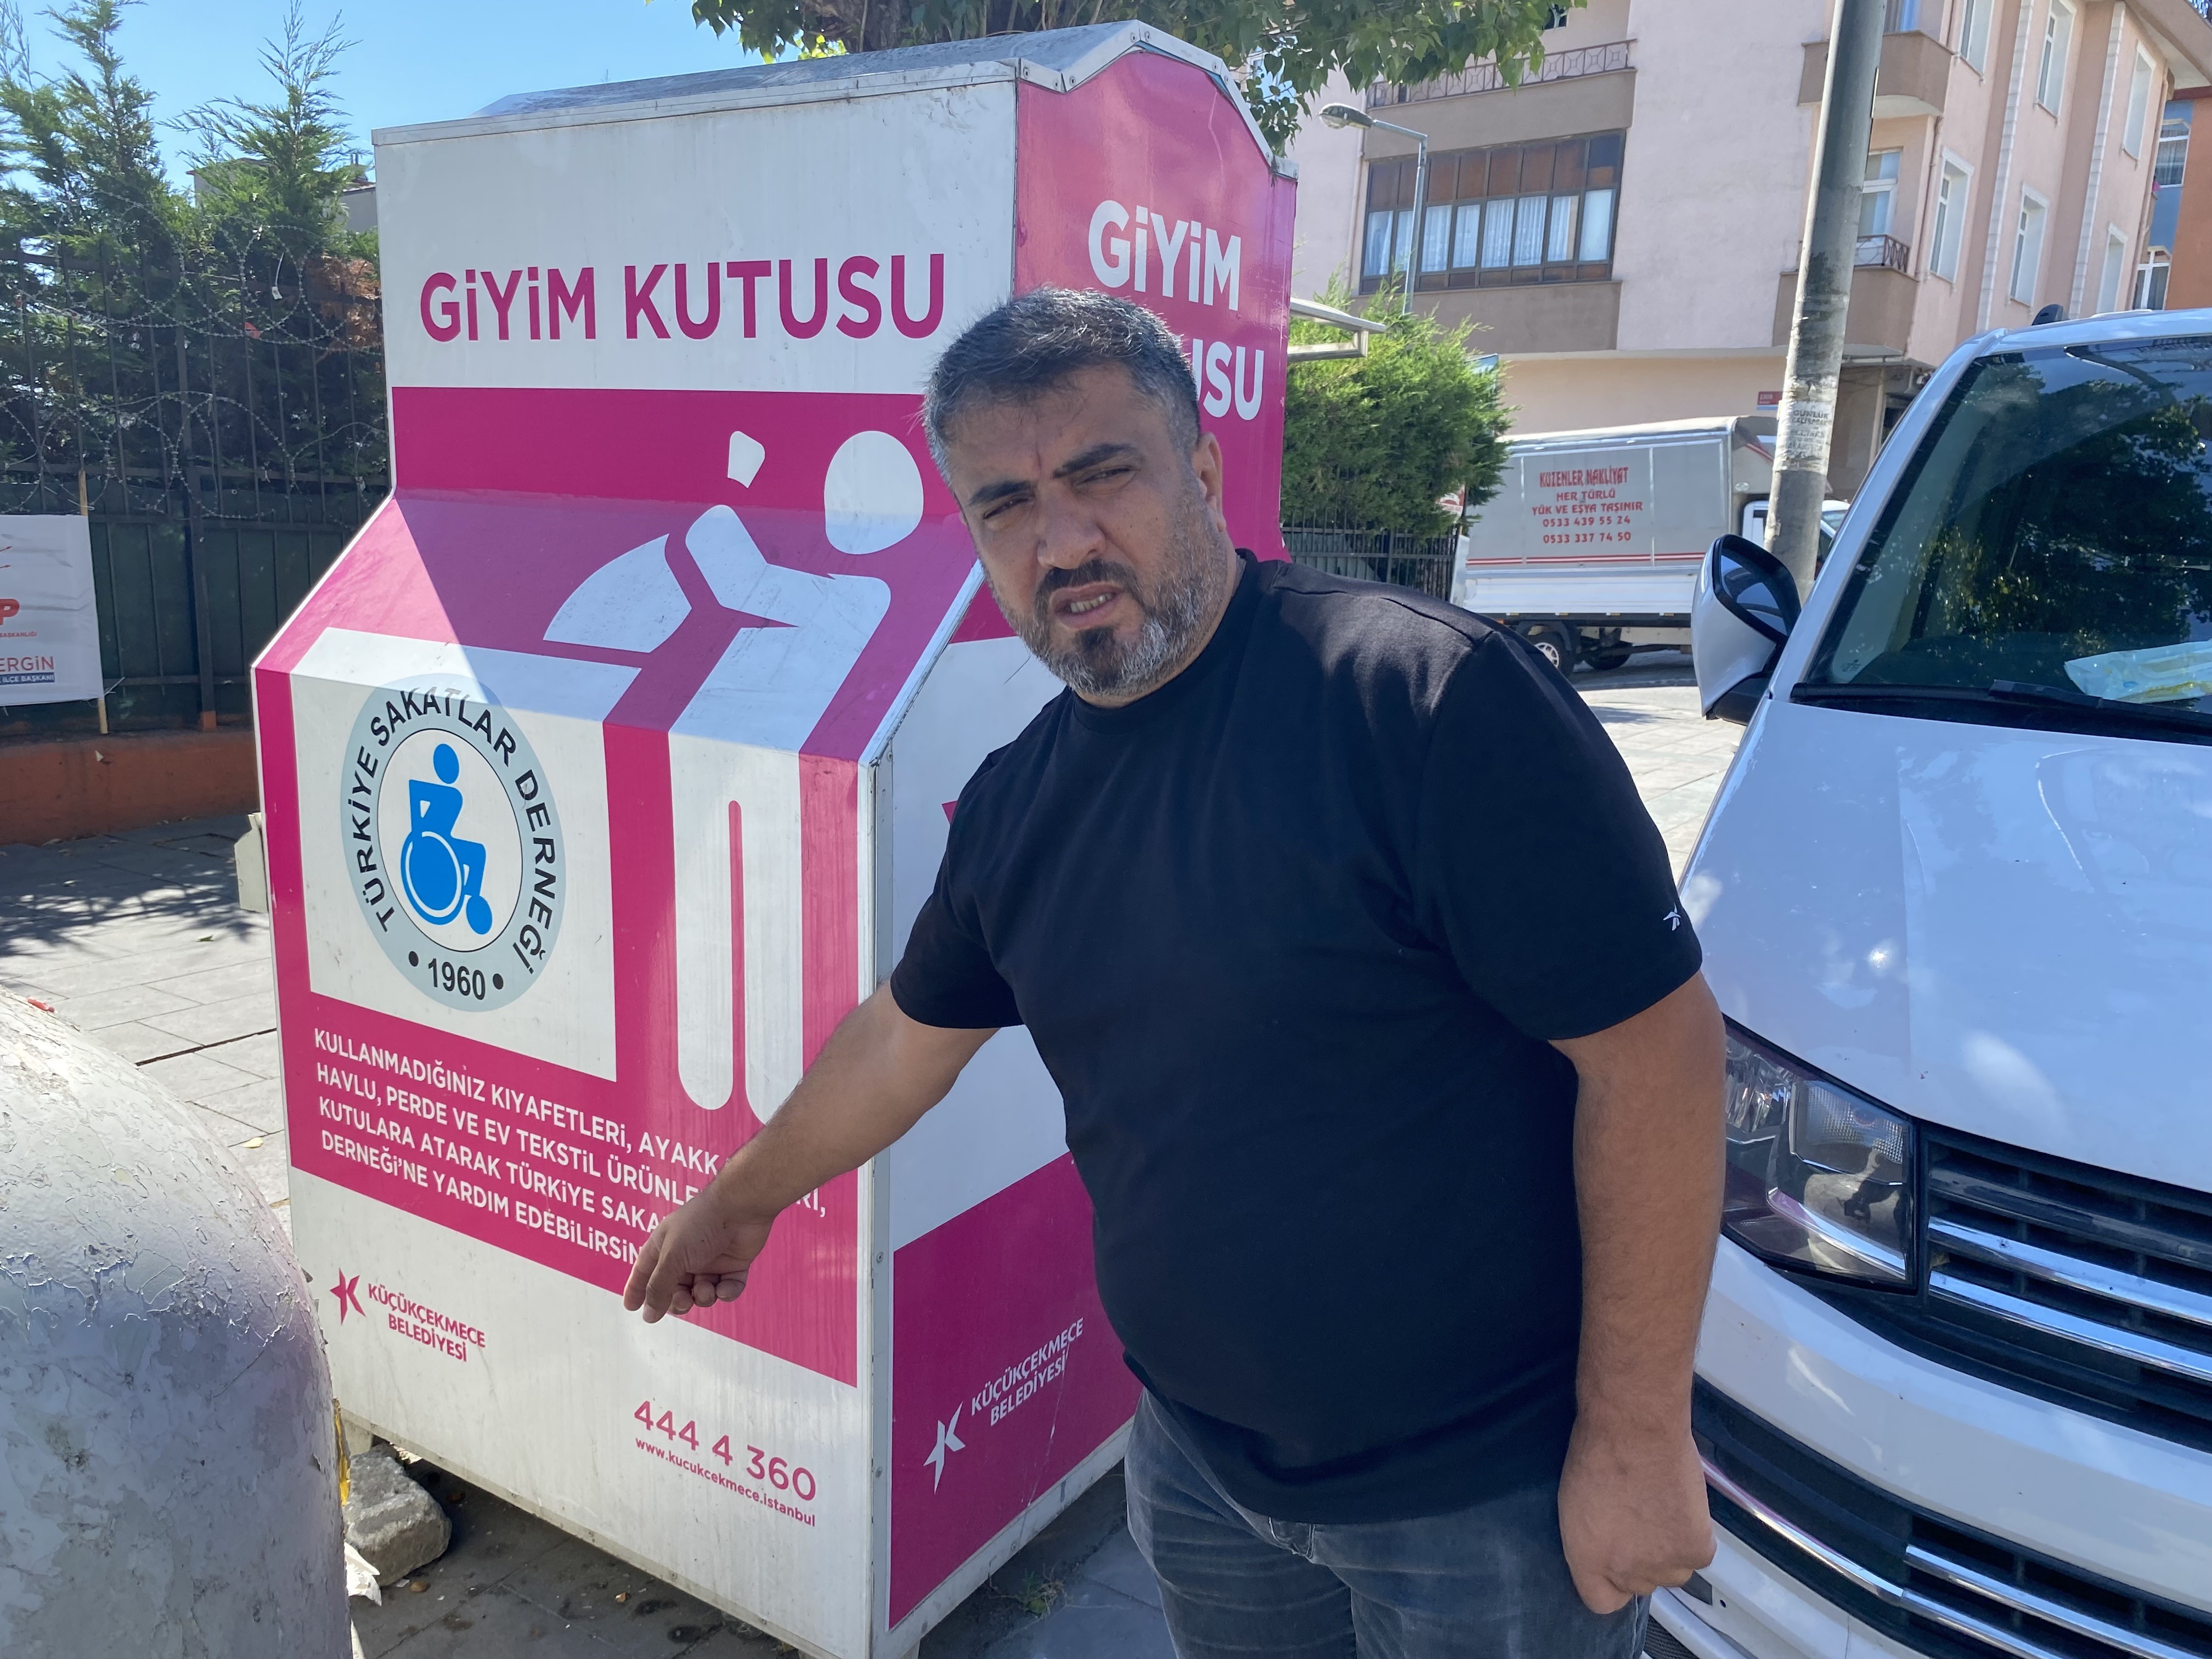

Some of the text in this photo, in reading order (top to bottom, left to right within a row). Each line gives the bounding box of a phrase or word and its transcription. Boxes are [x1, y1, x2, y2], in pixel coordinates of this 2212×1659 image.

[420, 252, 945, 342] GİYİM KUTUSU
[1088, 200, 1242, 312] GİYİM
[1532, 501, 1643, 515] YÜK VE EŞYA TAŞINIR
[1543, 515, 1630, 527] 0533 439 55 24
[1543, 531, 1631, 544] 0533 337 74 50
[1556, 488, 1616, 501] HER TÜRLÜ
[21, 674, 54, 682] BAŞKANI
[348, 686, 557, 975] TÜRKİYE SAKATLAR DERNEĞİ
[428, 957, 486, 1001] 1960
[314, 1028, 720, 1176] KULLANMADIĞINIZ KIYAFETLERİ, AYAKK
[317, 1062, 703, 1206] HAVLU, PERDE VE EV TEKSTİL ÜRÜNLE
[319, 1096, 663, 1233] KUTULARA ATARAK TÜRKİYE SAKA
[432, 1170, 509, 1218] YARDIM
[516, 1200, 642, 1265] EDEBİLİRSİN
[368, 1283, 486, 1348] KÜÇÜKÇEKMECE
[388, 1313, 467, 1363] BELEDİYESİ
[971, 1317, 1084, 1417] KÜÇÜKÇEKMECE
[990, 1349, 1066, 1427] BELEDİYESİ
[634, 1400, 816, 1501] 444 4 360
[635, 1437, 816, 1527] www.kucukcekmece.istanbul
